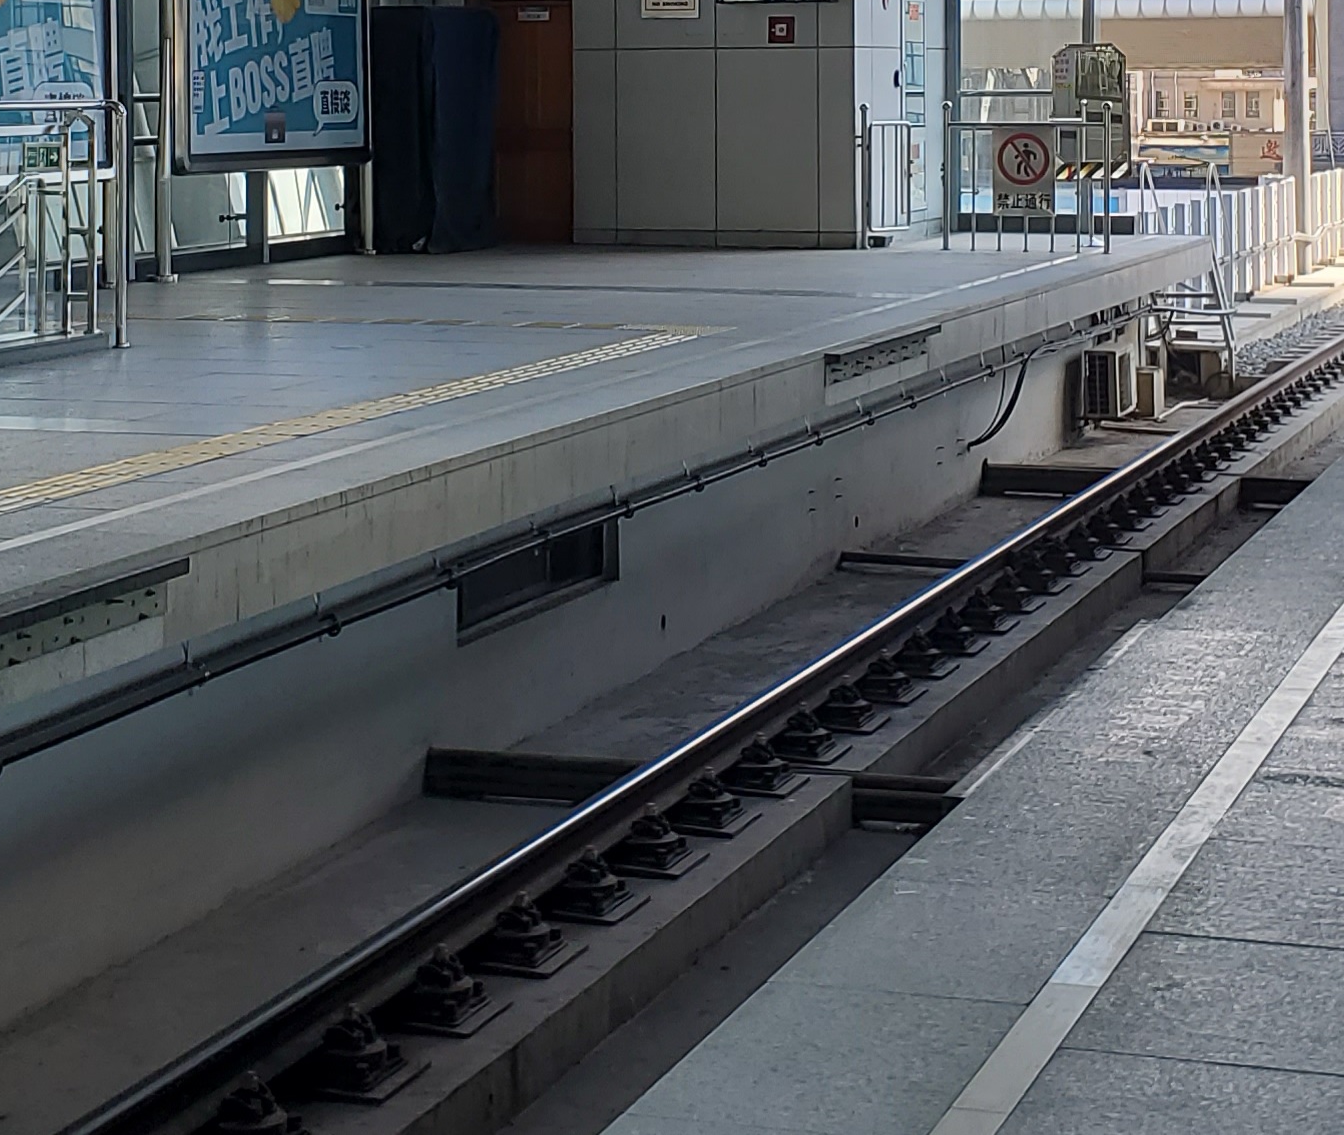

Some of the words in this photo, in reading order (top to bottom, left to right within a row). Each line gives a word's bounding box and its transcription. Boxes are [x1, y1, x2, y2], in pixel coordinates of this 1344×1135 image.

[204, 26, 335, 136] 上BOSS直聘
[320, 89, 351, 116] 直接谈
[996, 193, 1051, 210] 禁止通行
